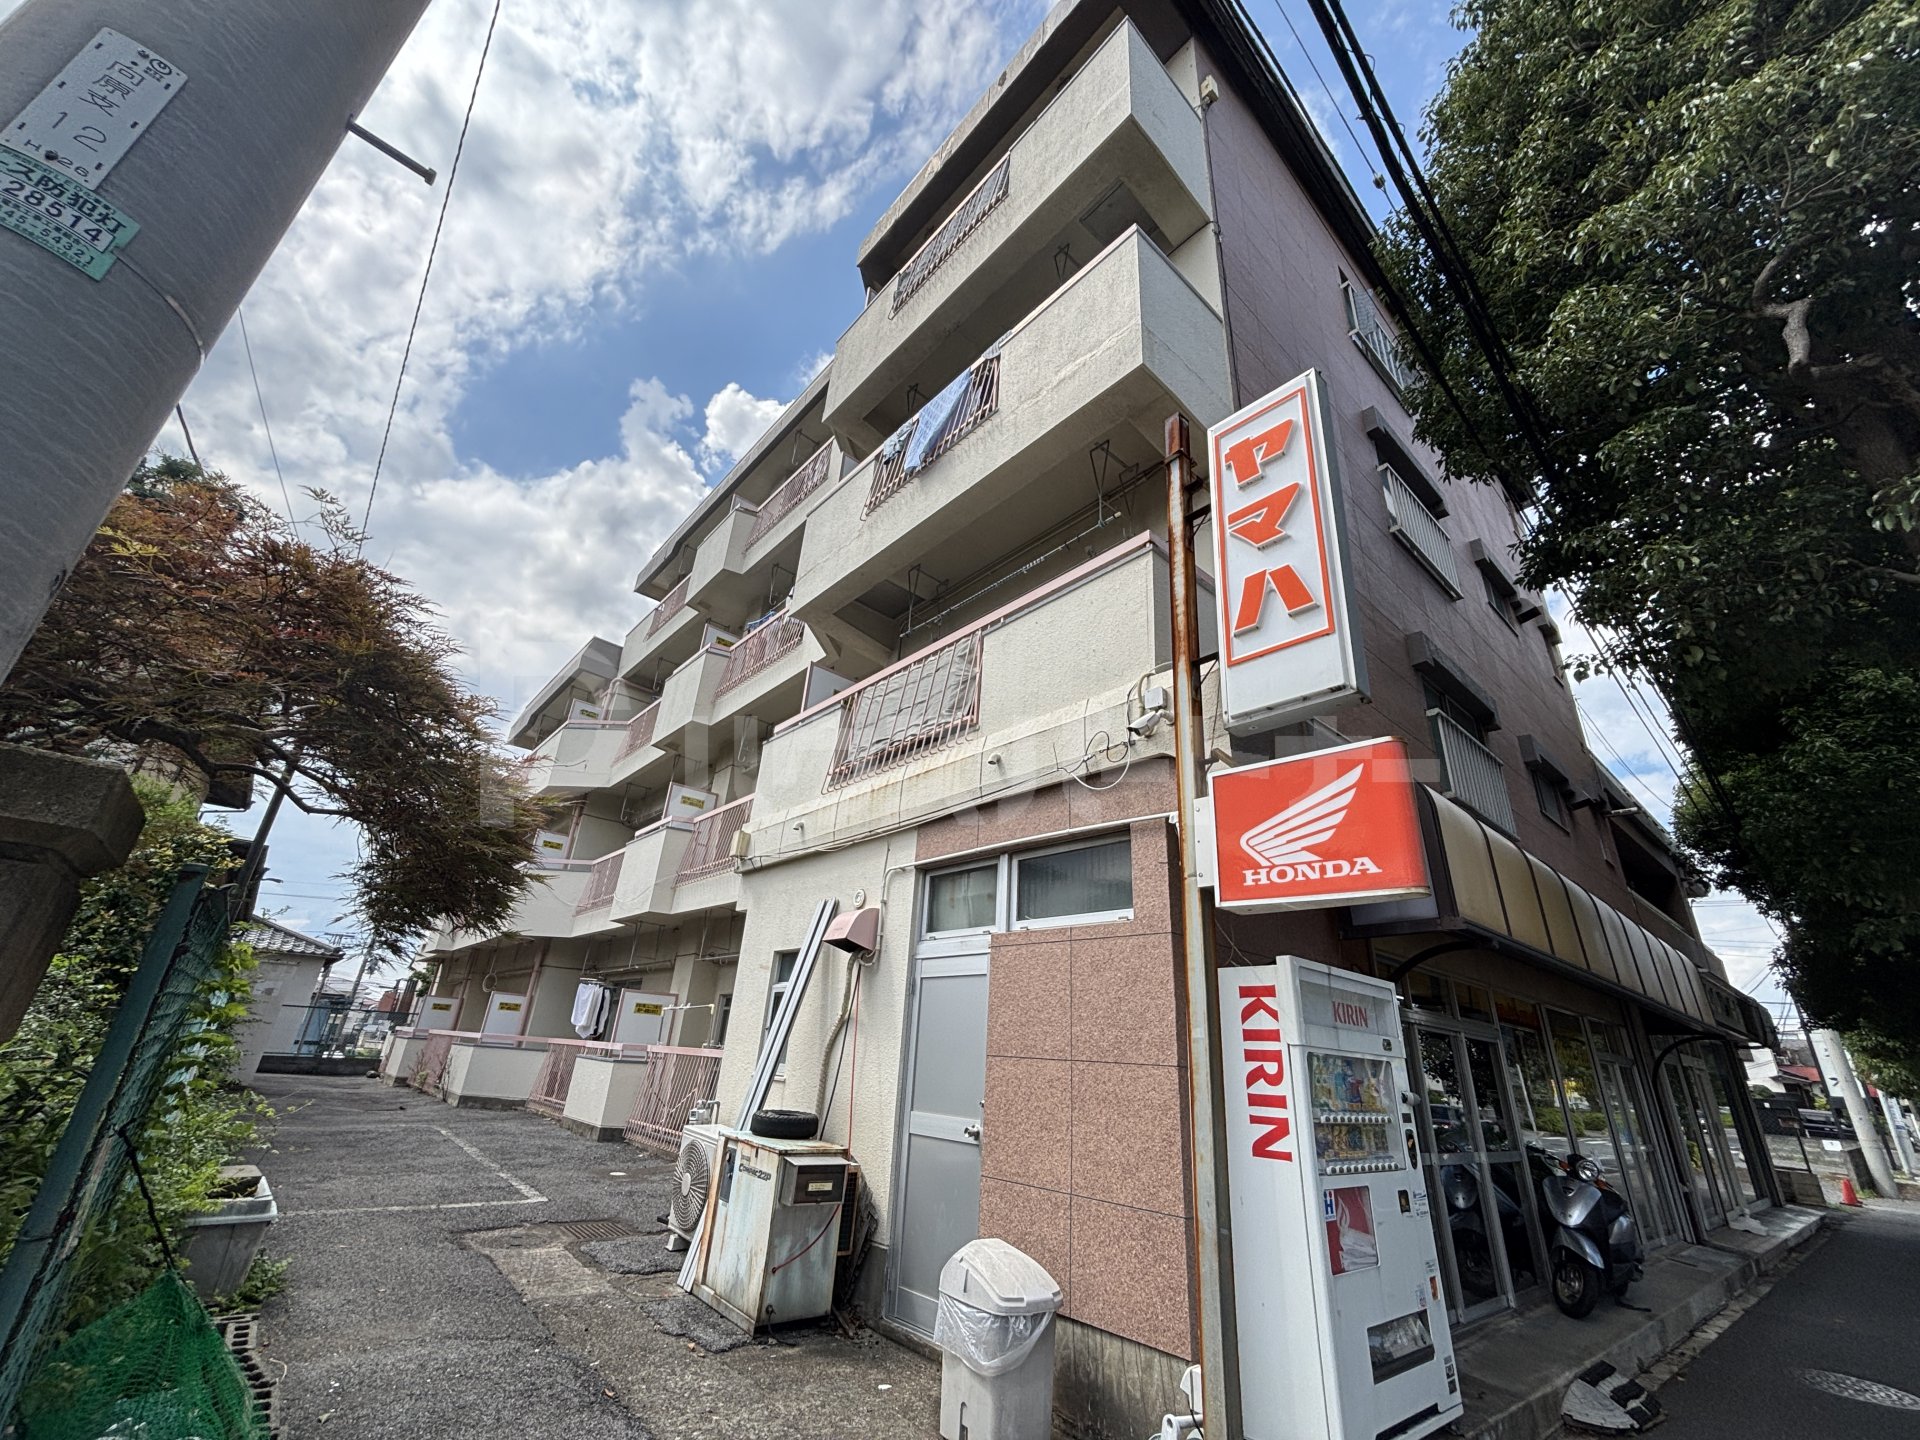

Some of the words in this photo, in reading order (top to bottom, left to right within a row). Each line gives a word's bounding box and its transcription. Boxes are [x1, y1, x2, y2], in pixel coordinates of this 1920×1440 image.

[79, 60, 147, 117] 向原支
[2, 180, 103, 242] 28514
[1224, 418, 1320, 637] ヤマハ
[1243, 856, 1383, 887] HONDA
[1332, 1001, 1369, 1029] KIRIN
[1238, 983, 1293, 1163] KIRIN
